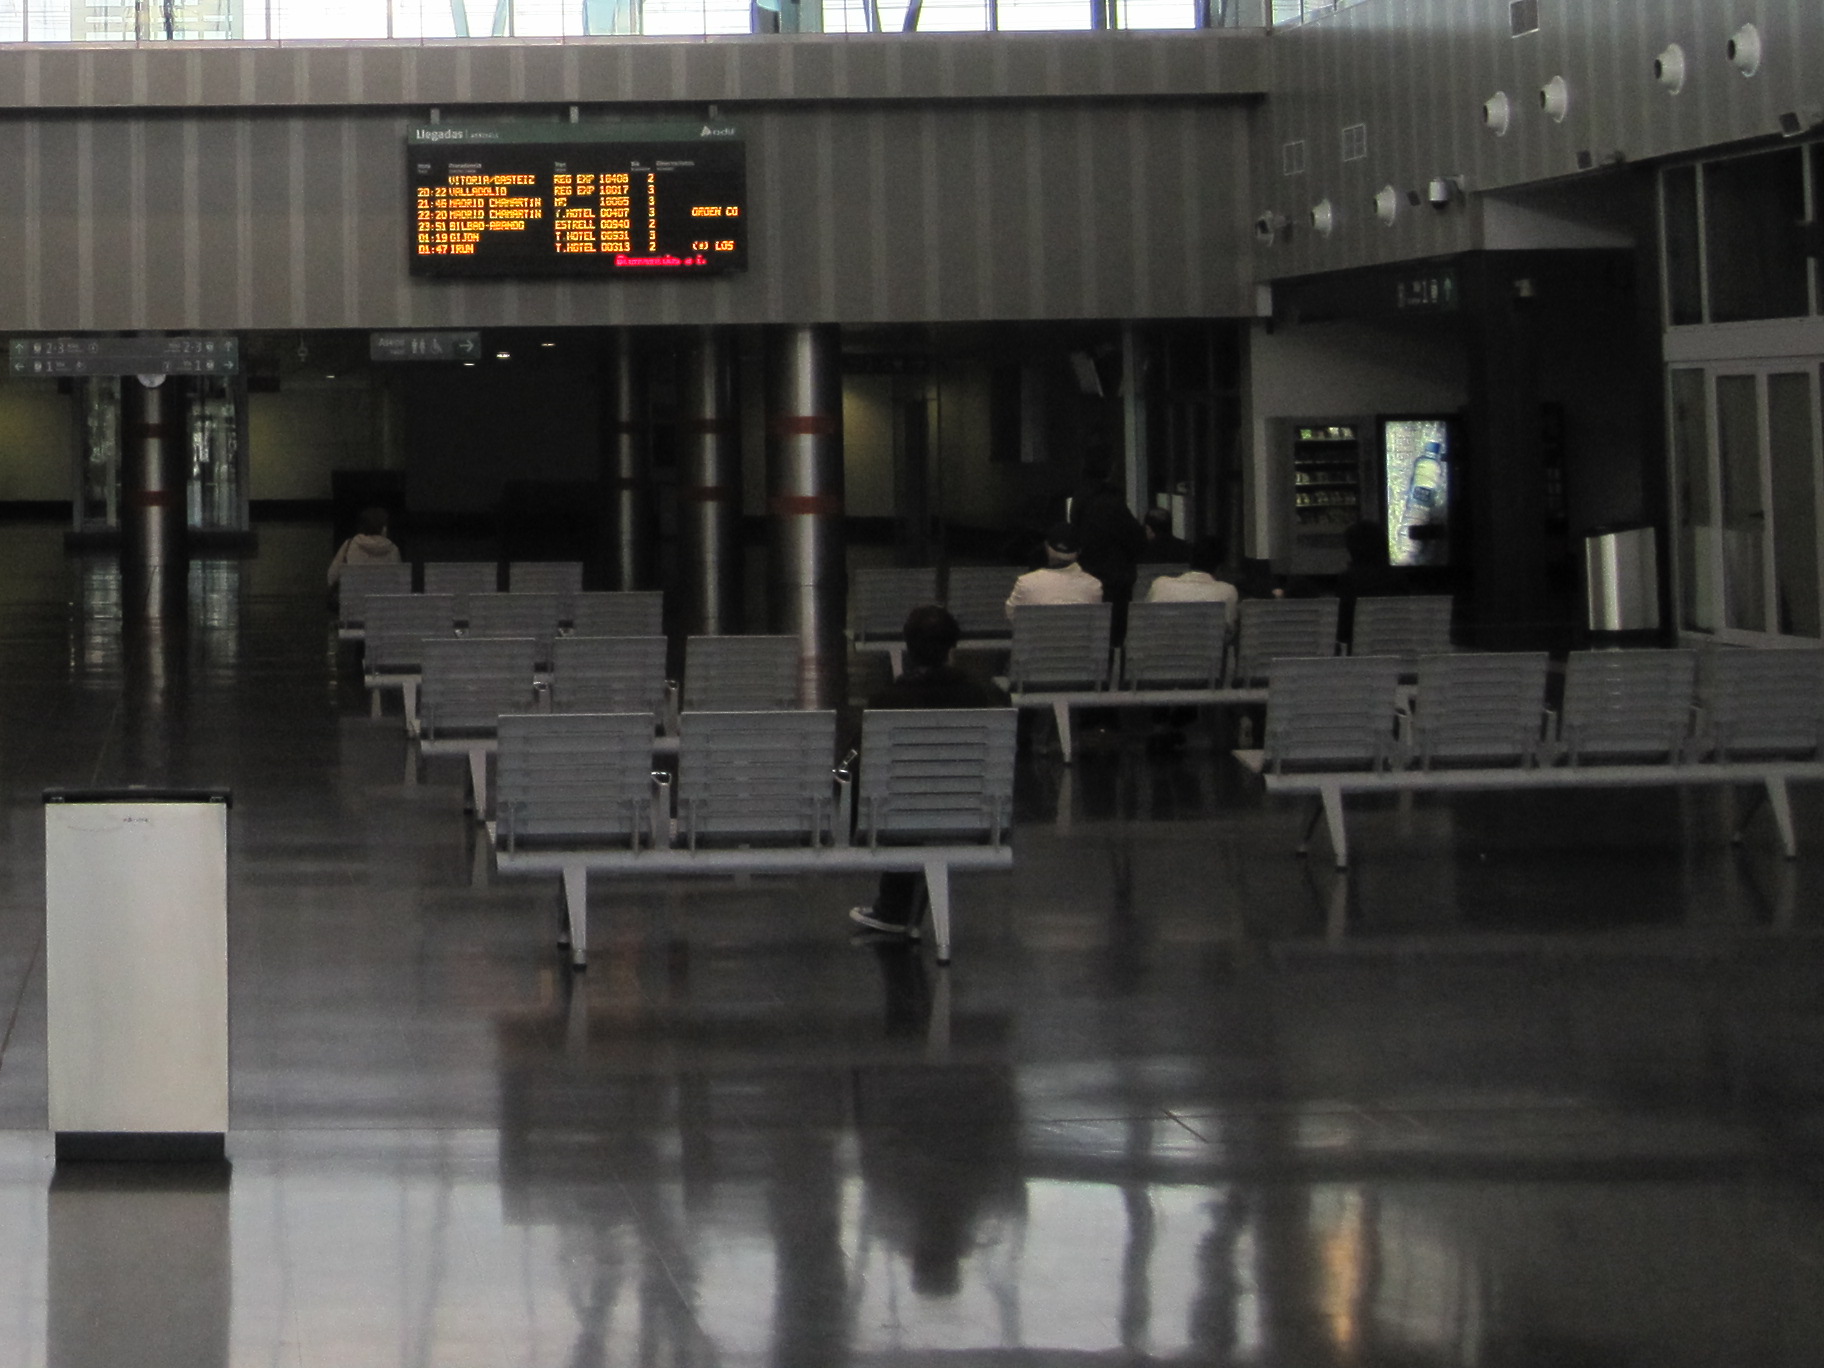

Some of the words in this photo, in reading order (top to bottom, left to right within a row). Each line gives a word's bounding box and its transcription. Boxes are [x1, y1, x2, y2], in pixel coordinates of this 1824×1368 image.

[416, 129, 464, 141] Llegadas
[554, 175, 572, 184] REG
[648, 174, 654, 183] 2
[449, 187, 507, 196] VALLADOLID
[554, 186, 572, 195] REG
[648, 185, 654, 194] 3
[449, 198, 484, 208] MADRID
[489, 198, 542, 208] CHAMARTIN
[648, 196, 655, 206] 3
[449, 210, 485, 220] MADRID
[489, 210, 542, 219] CHAMARTIN
[648, 208, 655, 217] 3
[555, 221, 596, 229] ESTRELL
[649, 219, 655, 228] 2
[418, 234, 447, 243] 01:19
[649, 231, 656, 240] 3
[418, 245, 447, 254] 01:47
[649, 242, 656, 251] 2
